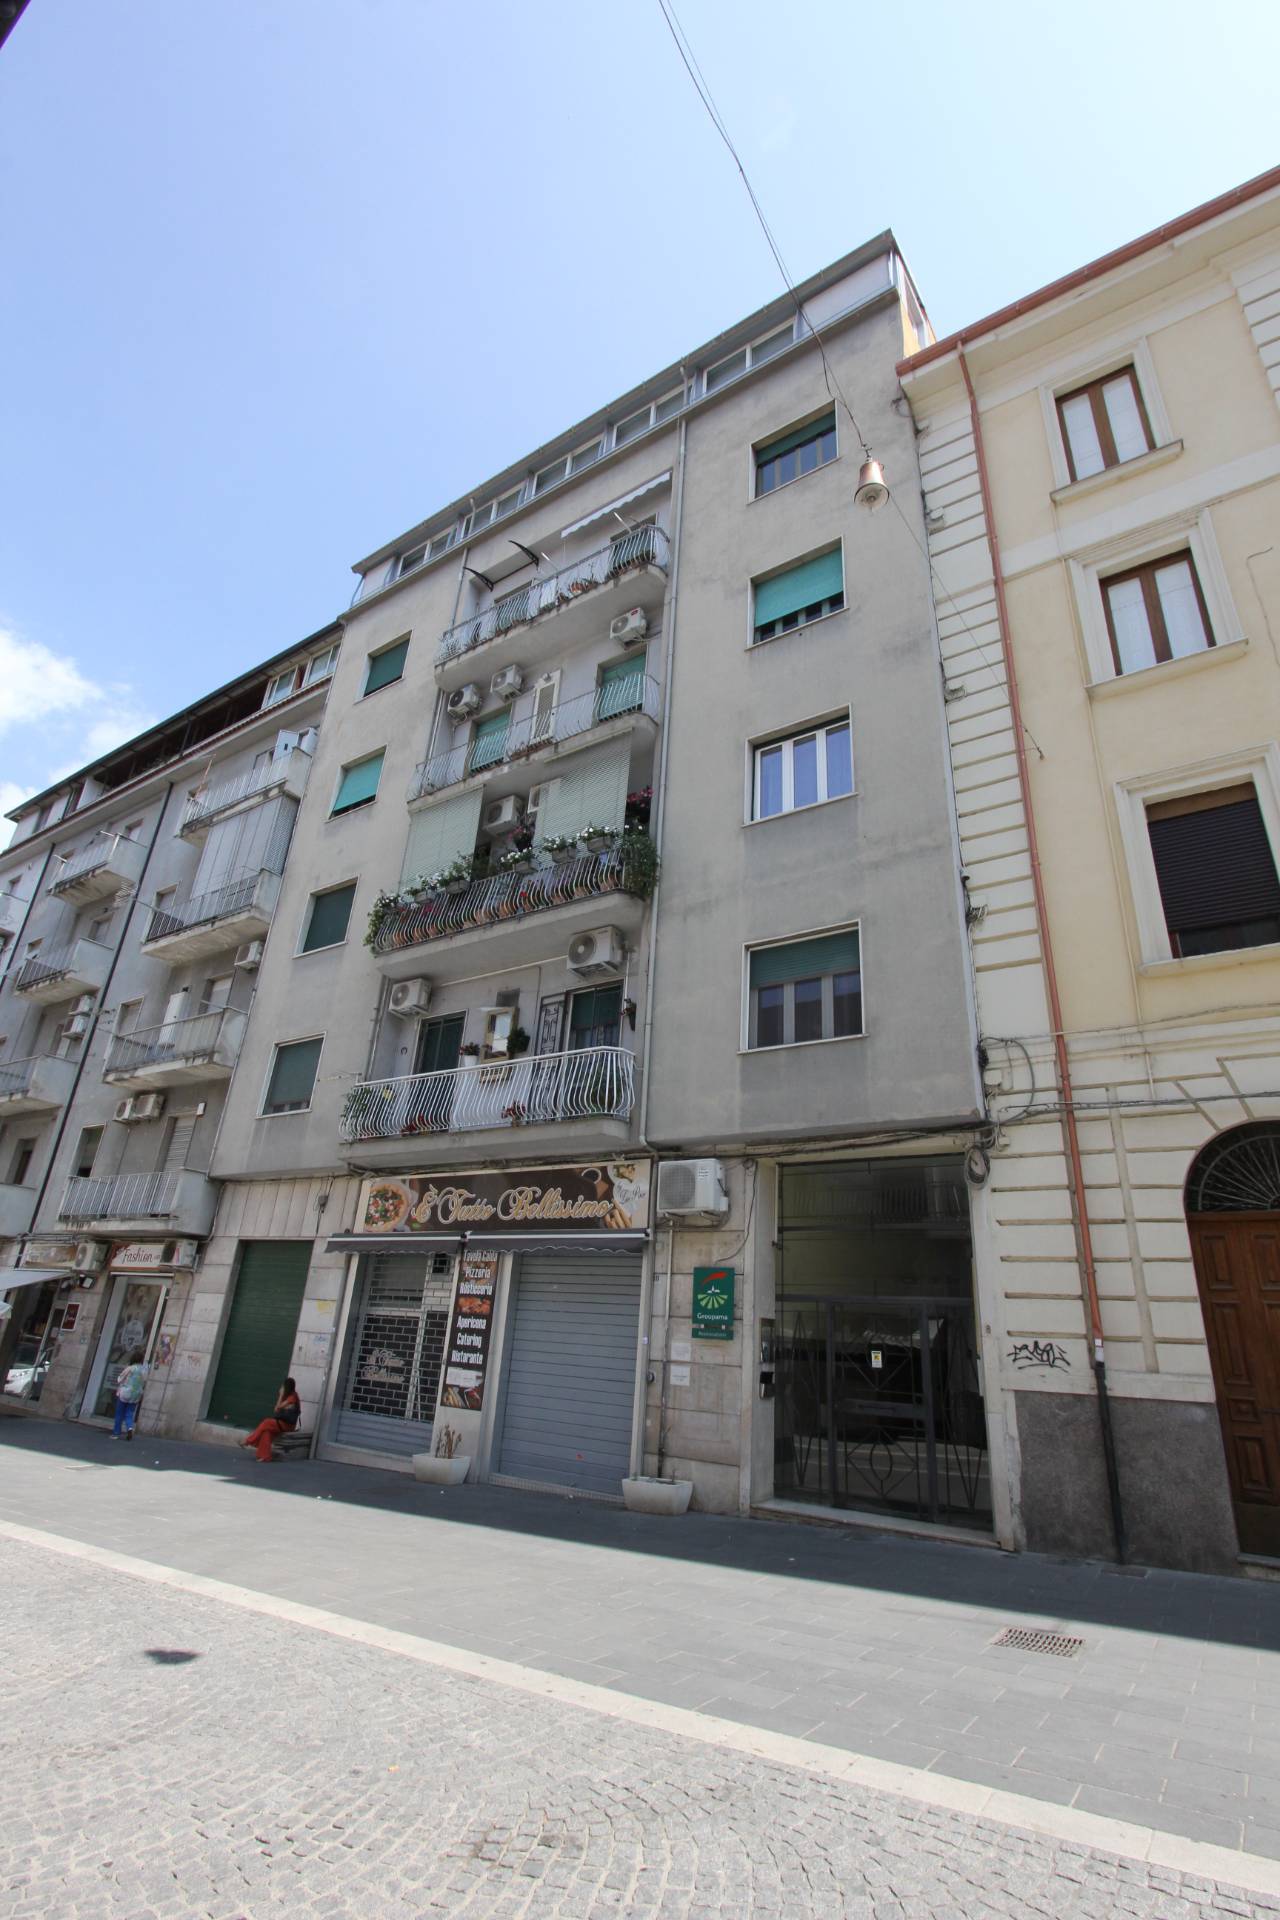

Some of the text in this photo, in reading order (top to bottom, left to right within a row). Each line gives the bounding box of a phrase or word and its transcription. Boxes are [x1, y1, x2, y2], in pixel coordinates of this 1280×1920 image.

[437, 1187, 496, 1224] Tutto
[497, 1186, 613, 1220] Bellissimo
[122, 1246, 153, 1264] Fashion
[465, 1266, 491, 1278] Pizzeria
[456, 1315, 487, 1330] Apericena
[696, 1312, 728, 1321] Groupama
[457, 1333, 482, 1348] Catering
[451, 1350, 483, 1365] Ristorante
